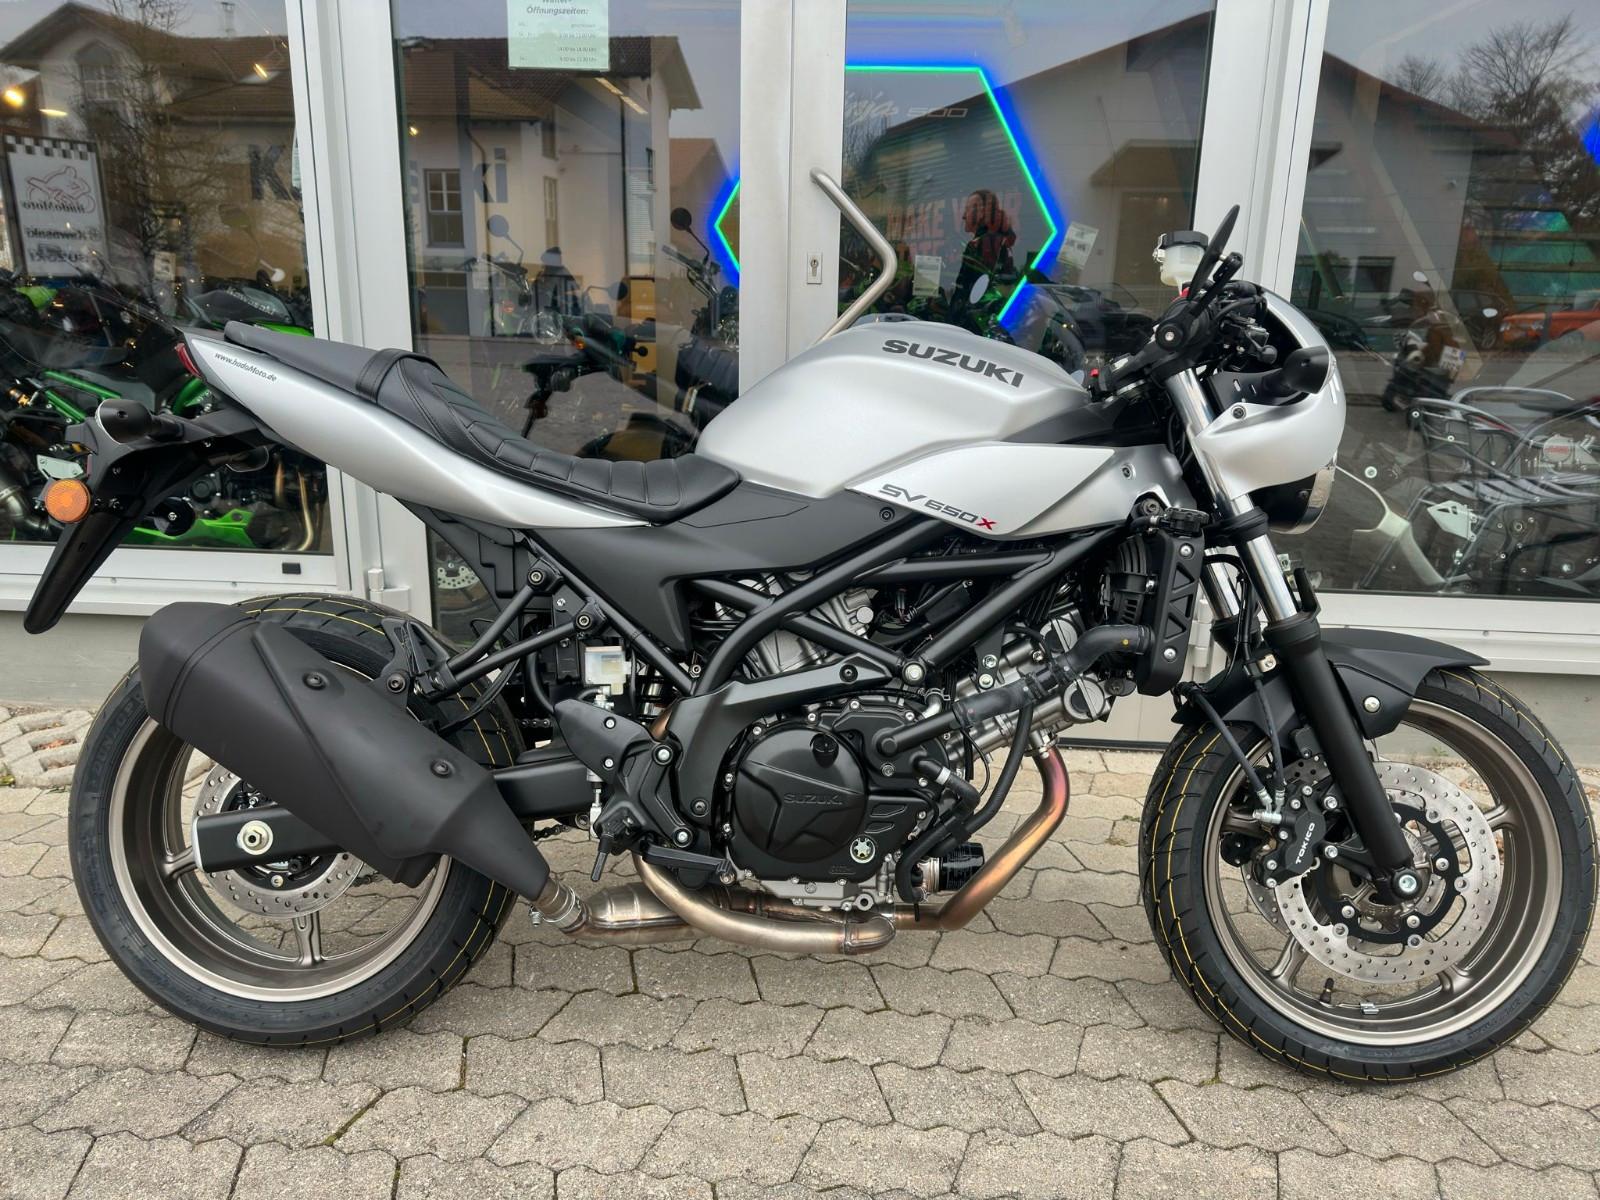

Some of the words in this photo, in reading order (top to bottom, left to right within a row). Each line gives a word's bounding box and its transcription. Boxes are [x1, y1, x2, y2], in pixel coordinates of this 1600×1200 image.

[526, 6, 589, 16] Öffnungszeiten:
[886, 199, 945, 240] MAKE
[882, 339, 1025, 388] SUZUKI
[1295, 822, 1316, 865] TOKICO
